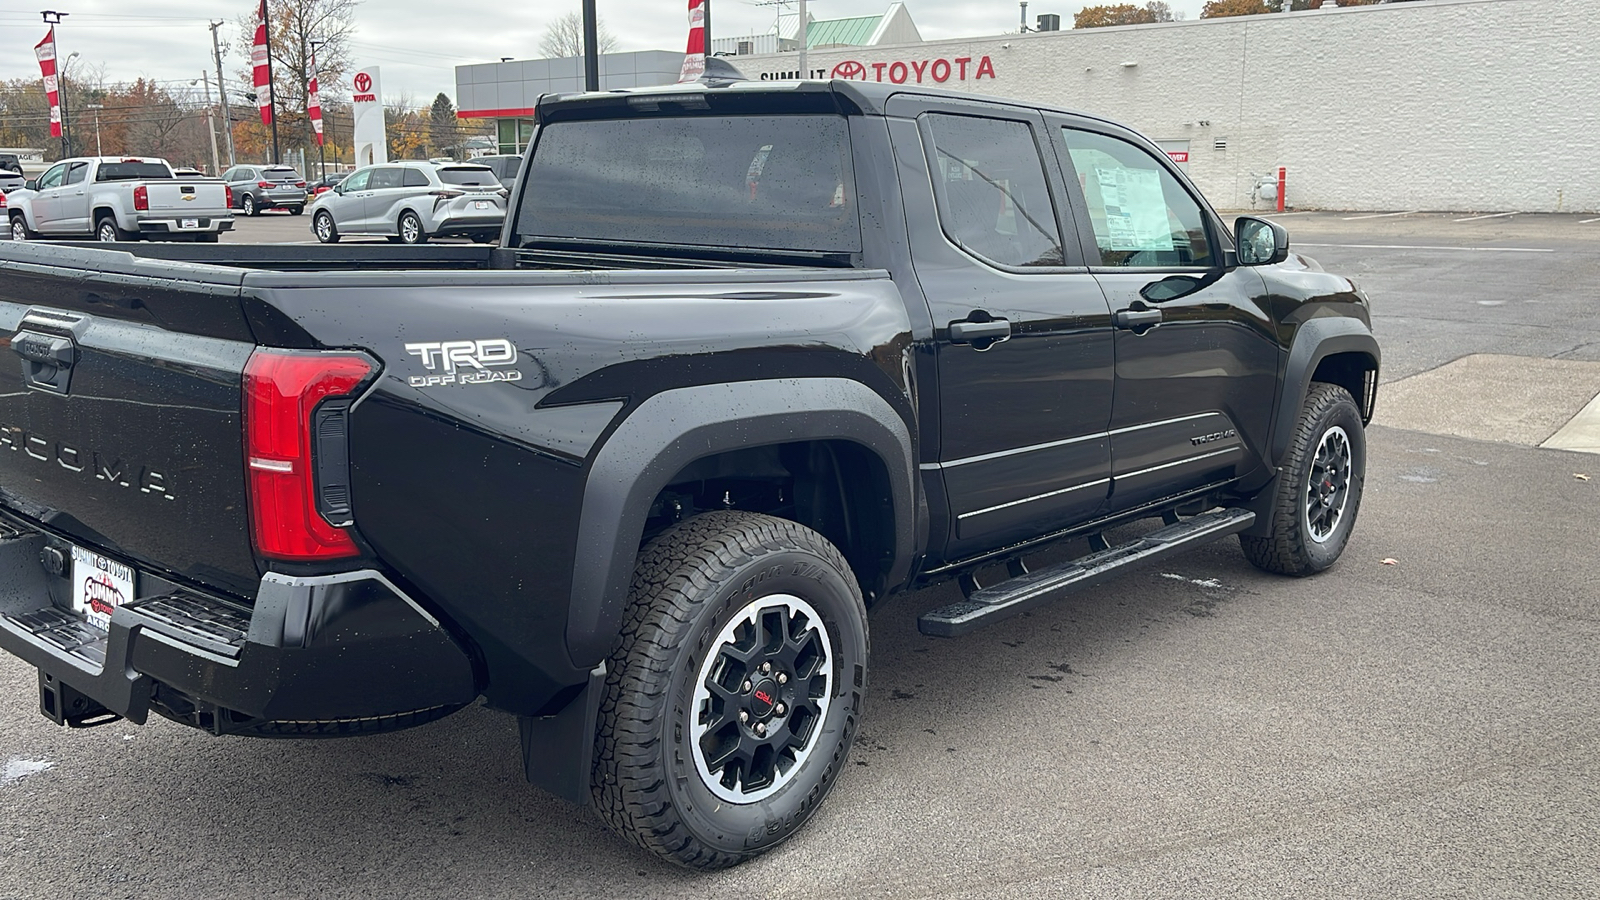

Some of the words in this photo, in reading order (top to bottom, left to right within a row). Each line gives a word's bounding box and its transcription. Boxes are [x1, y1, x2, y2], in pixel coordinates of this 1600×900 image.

[872, 55, 996, 84] TOYOTA
[353, 94, 376, 102] TOYOTA
[404, 339, 518, 375] TRD
[408, 374, 456, 387] OFF
[458, 370, 523, 384] ROAD
[1190, 429, 1235, 446] TACOMA
[72, 546, 98, 569] SUMMIT
[107, 560, 132, 583] TOYOTA
[755, 690, 773, 706] TRD
